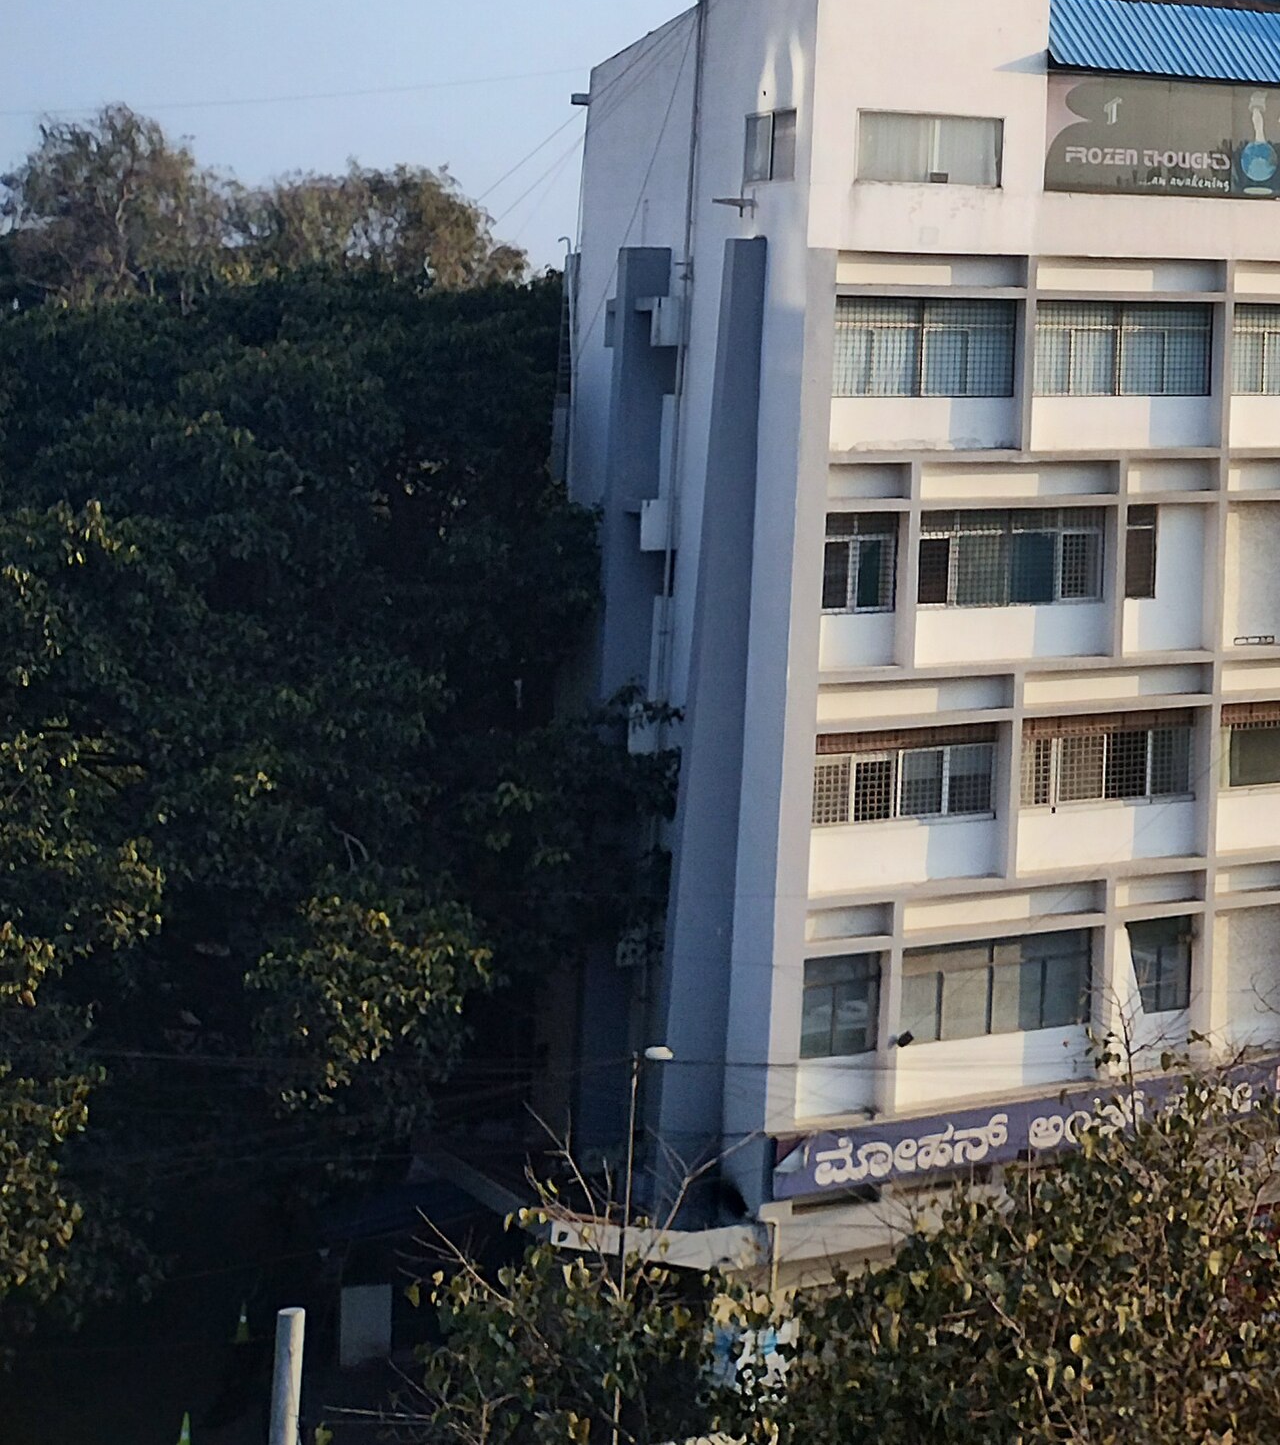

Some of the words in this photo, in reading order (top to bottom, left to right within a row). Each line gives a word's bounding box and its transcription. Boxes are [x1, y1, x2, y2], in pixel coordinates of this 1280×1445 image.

[1065, 145, 1138, 166] FROZEN
[1143, 149, 1231, 171] THOUGHTS
[1169, 175, 1231, 193] awakening
[814, 1112, 1009, 1186] ಮೋಹನ್
